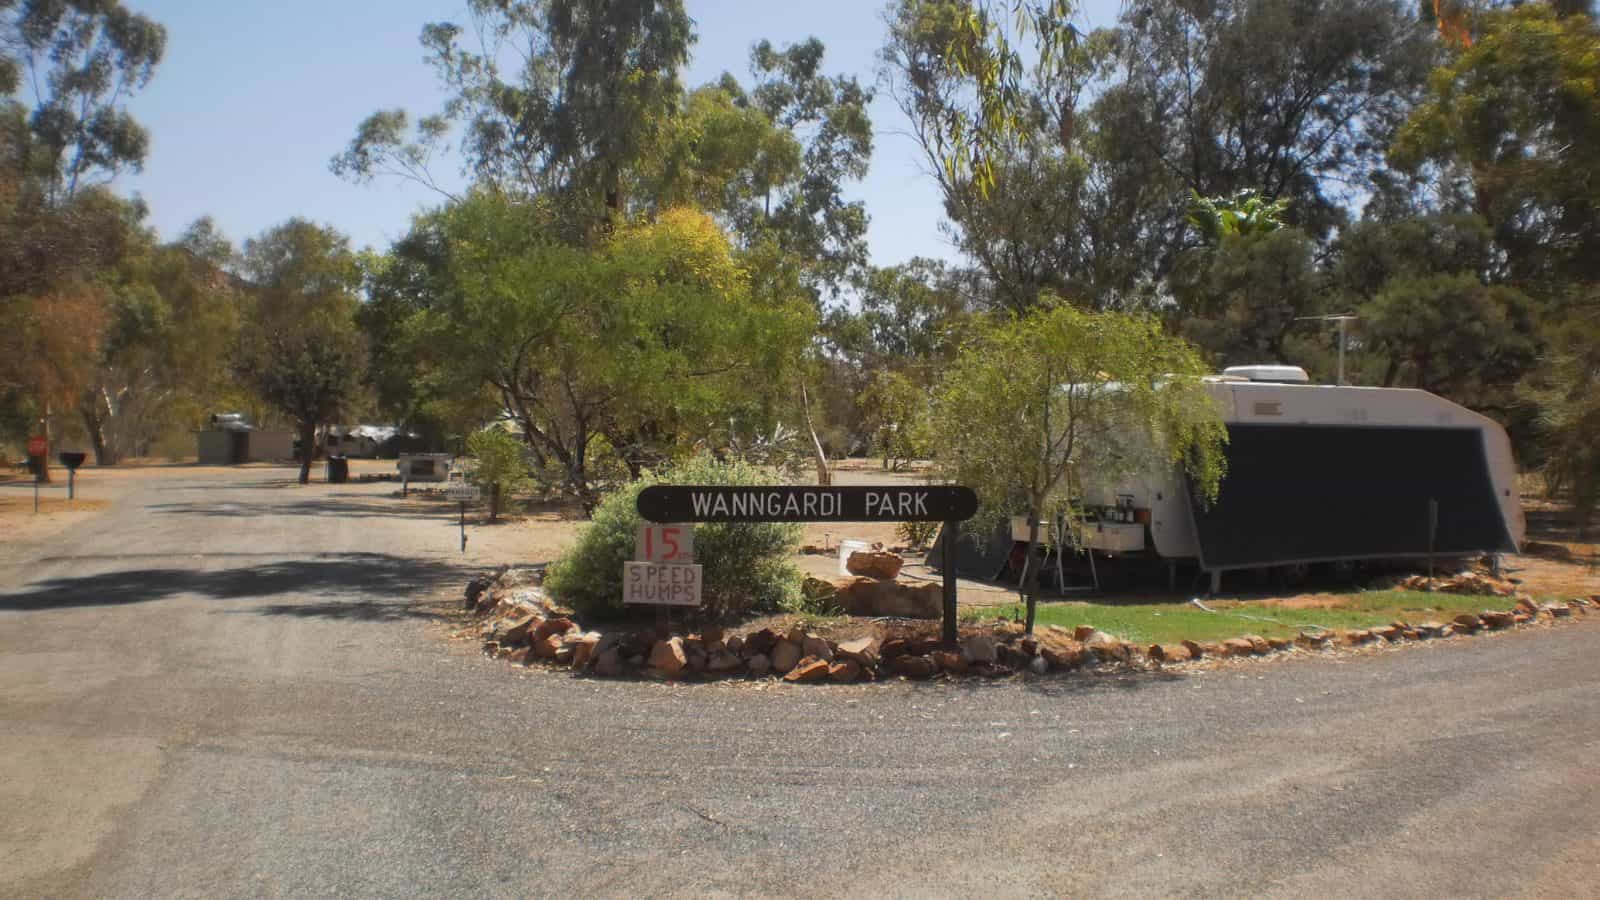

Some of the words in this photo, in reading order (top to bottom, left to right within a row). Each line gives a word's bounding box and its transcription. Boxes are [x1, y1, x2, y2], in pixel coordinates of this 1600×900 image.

[691, 492, 842, 517] WANNGARDI
[865, 492, 929, 516] PARK
[645, 527, 681, 560] 15
[630, 566, 696, 584] SPEED
[630, 584, 696, 602] HUMPS
